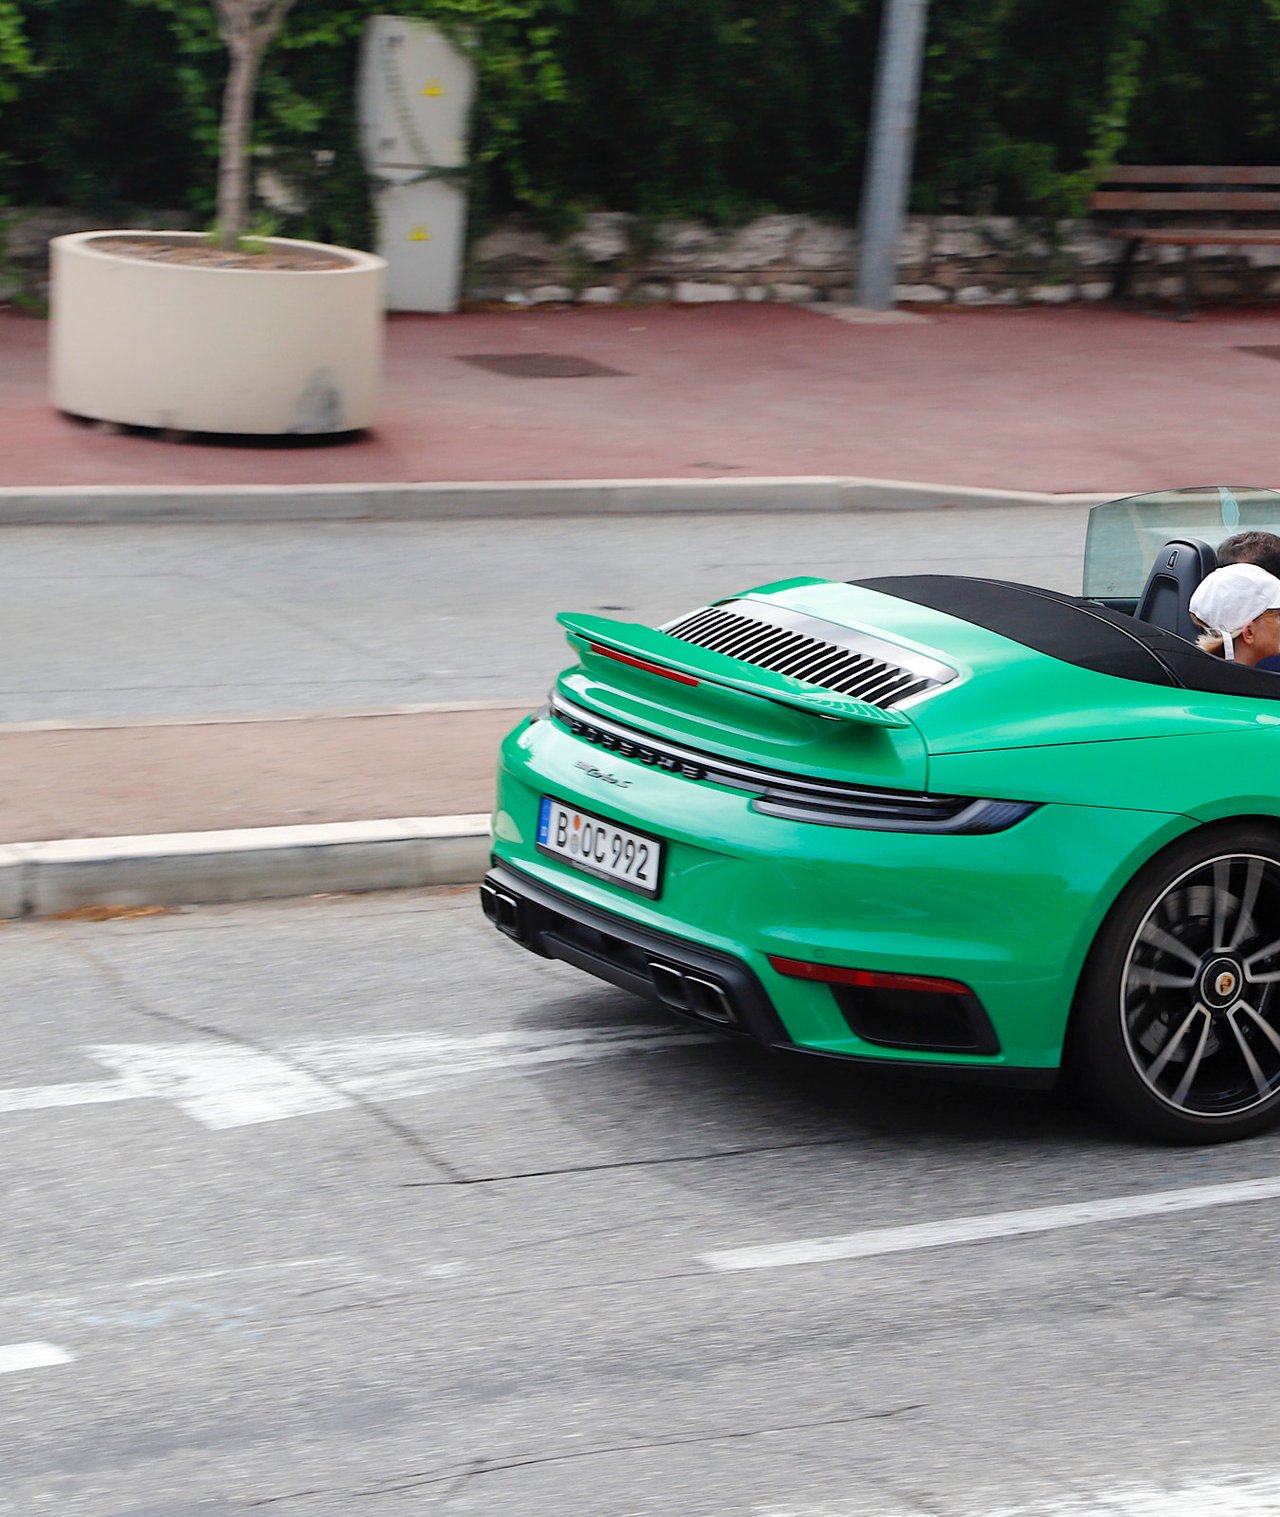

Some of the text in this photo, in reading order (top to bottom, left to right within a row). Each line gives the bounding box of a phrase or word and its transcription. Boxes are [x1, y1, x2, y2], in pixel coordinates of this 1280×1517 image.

[557, 812, 568, 847] B
[582, 823, 606, 863] OC
[612, 834, 649, 880] 992
